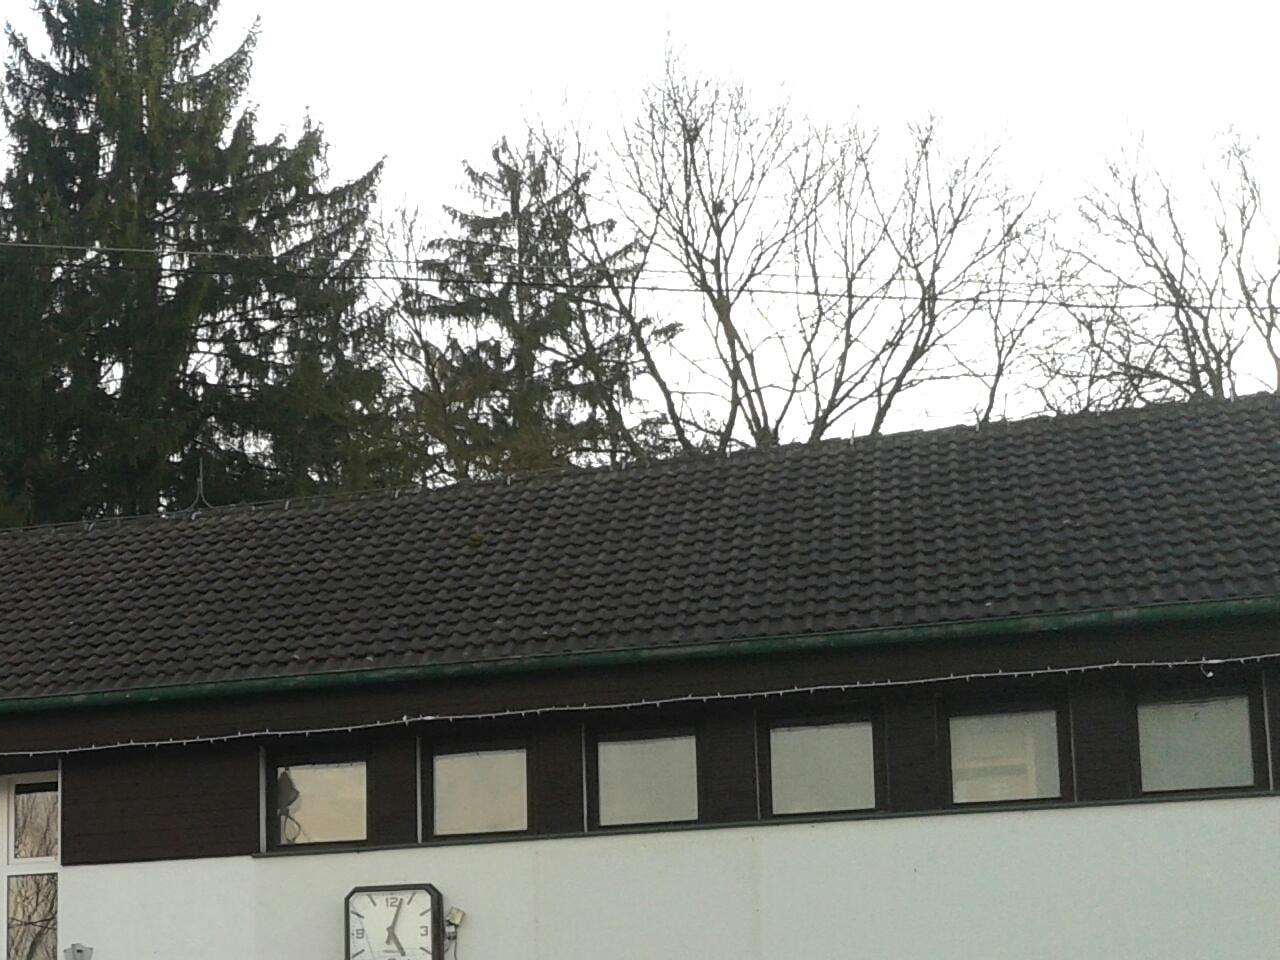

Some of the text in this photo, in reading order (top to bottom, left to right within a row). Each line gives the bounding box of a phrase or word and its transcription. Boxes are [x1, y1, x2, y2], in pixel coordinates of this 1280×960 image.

[385, 897, 399, 907] 12
[356, 928, 365, 939] 9
[420, 926, 429, 936] 3
